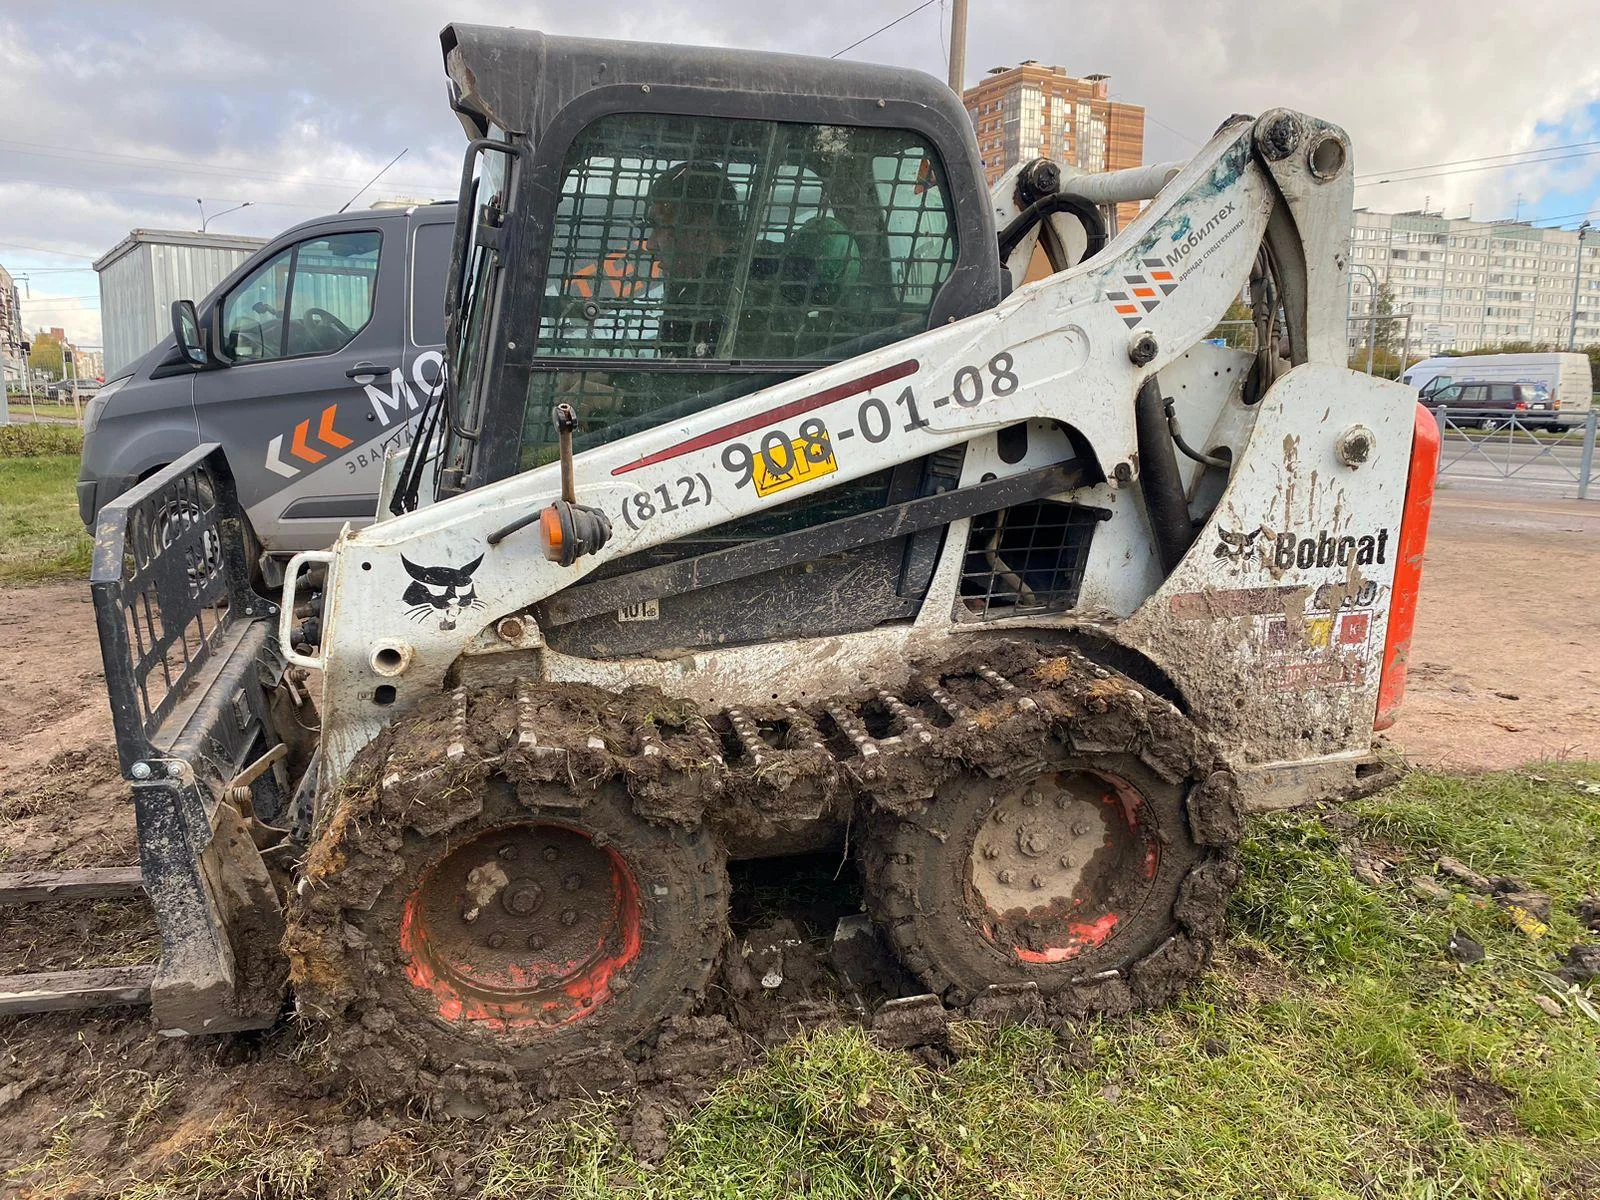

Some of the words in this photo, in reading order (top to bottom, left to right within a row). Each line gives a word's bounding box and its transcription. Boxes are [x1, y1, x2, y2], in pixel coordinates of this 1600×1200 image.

[1165, 201, 1236, 267] Мобилтех
[1178, 257, 1203, 282] аренда
[1203, 218, 1246, 259] спецтехники
[621, 472, 713, 531] (812)
[721, 351, 1019, 490] 908-01-08
[1275, 528, 1389, 570] Bobcat
